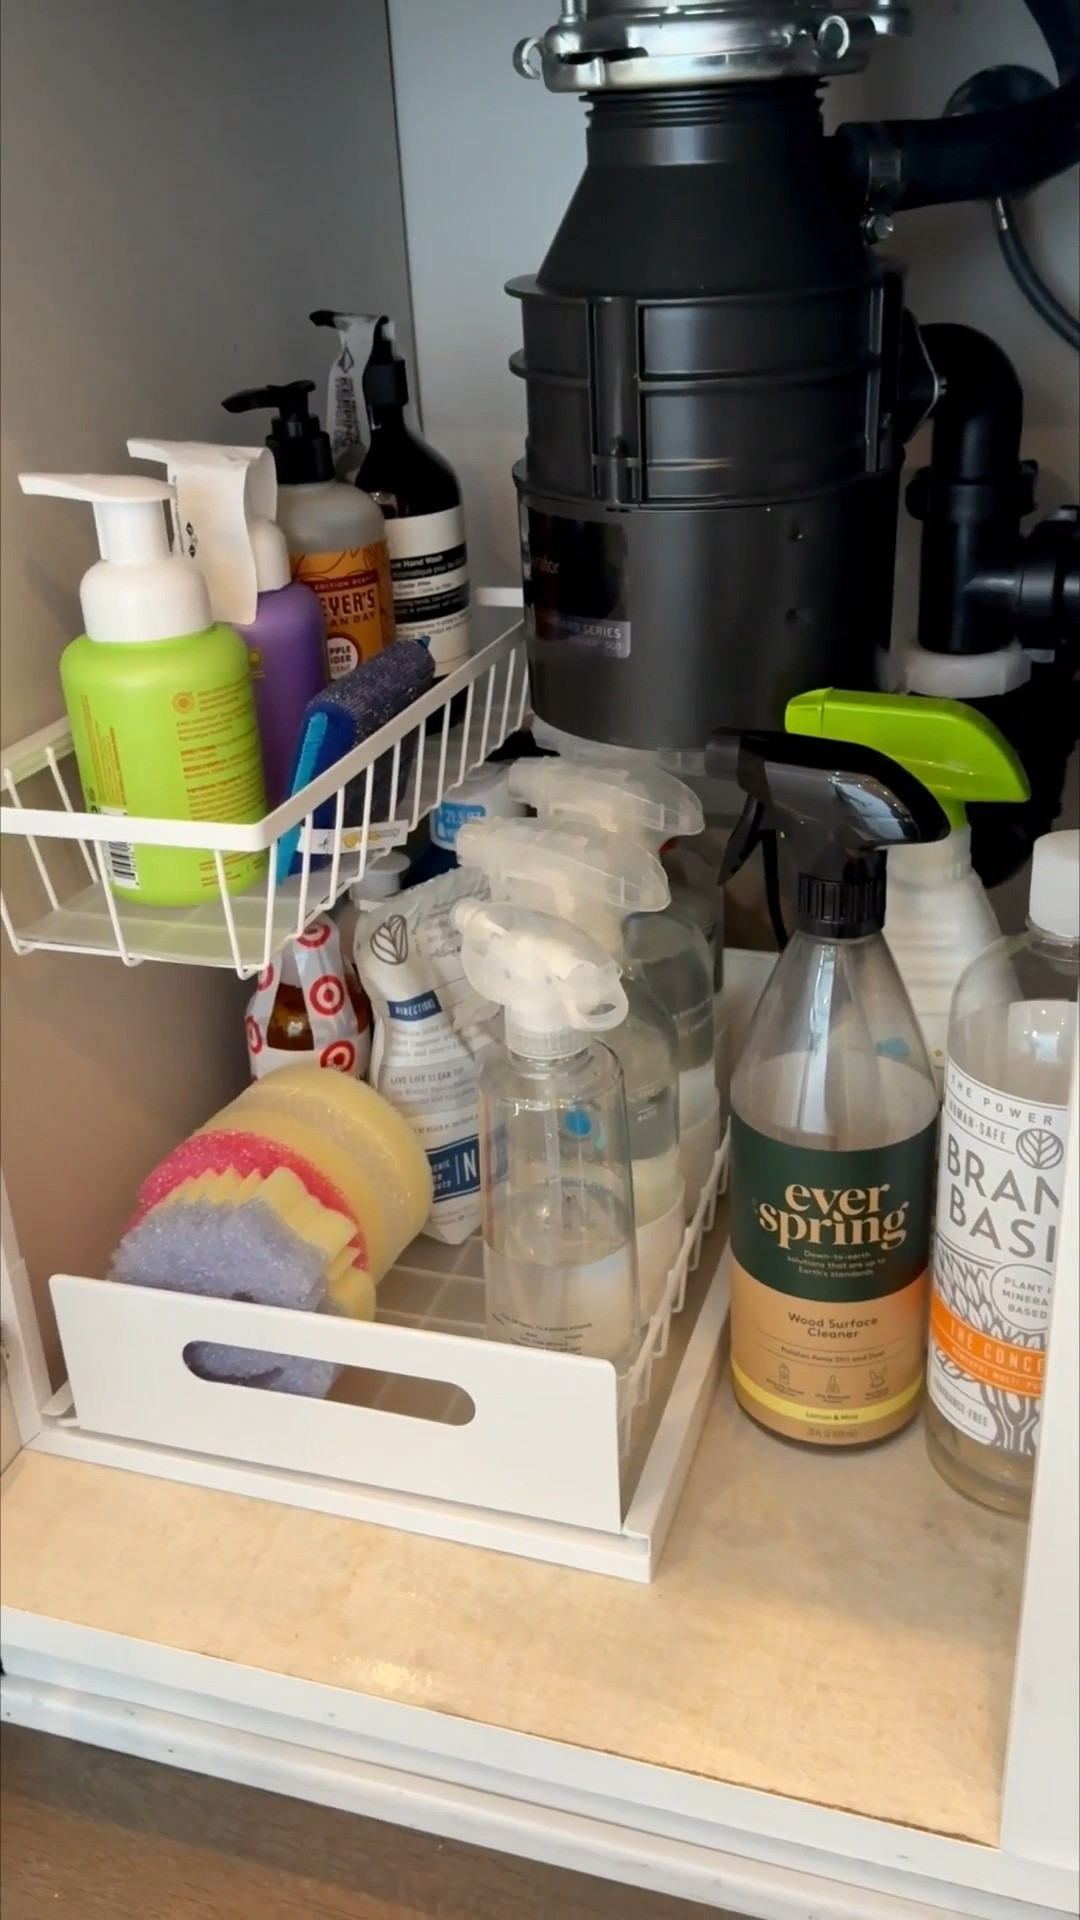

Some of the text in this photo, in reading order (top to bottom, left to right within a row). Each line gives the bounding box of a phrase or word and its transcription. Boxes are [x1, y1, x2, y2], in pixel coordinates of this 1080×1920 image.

[320, 589, 375, 617] EYER'S
[353, 612, 375, 625] DAY
[583, 624, 622, 640] SERIES
[329, 645, 351, 656] PPLE
[330, 655, 352, 665] IDER
[428, 1070, 451, 1082] CLEAN
[951, 1074, 1053, 1126] THE POWER
[463, 1149, 477, 1182] N
[947, 1133, 1060, 1215] BRAN
[785, 1183, 890, 1216] ever
[759, 1201, 910, 1251] spring
[949, 1183, 1056, 1263] BASI
[803, 1249, 872, 1261] Down-to-earth
[827, 1261, 847, 1270] that
[865, 1260, 876, 1269] up
[1004, 1276, 1042, 1293] PLANT
[1002, 1289, 1048, 1307] MINERA
[1008, 1303, 1047, 1319] BASED
[788, 1312, 878, 1329] Wood Surface
[807, 1327, 859, 1339] Cleaner
[951, 1322, 1045, 1375] THE CONCE
[852, 1354, 867, 1362] and
[833, 1413, 839, 1421] &
